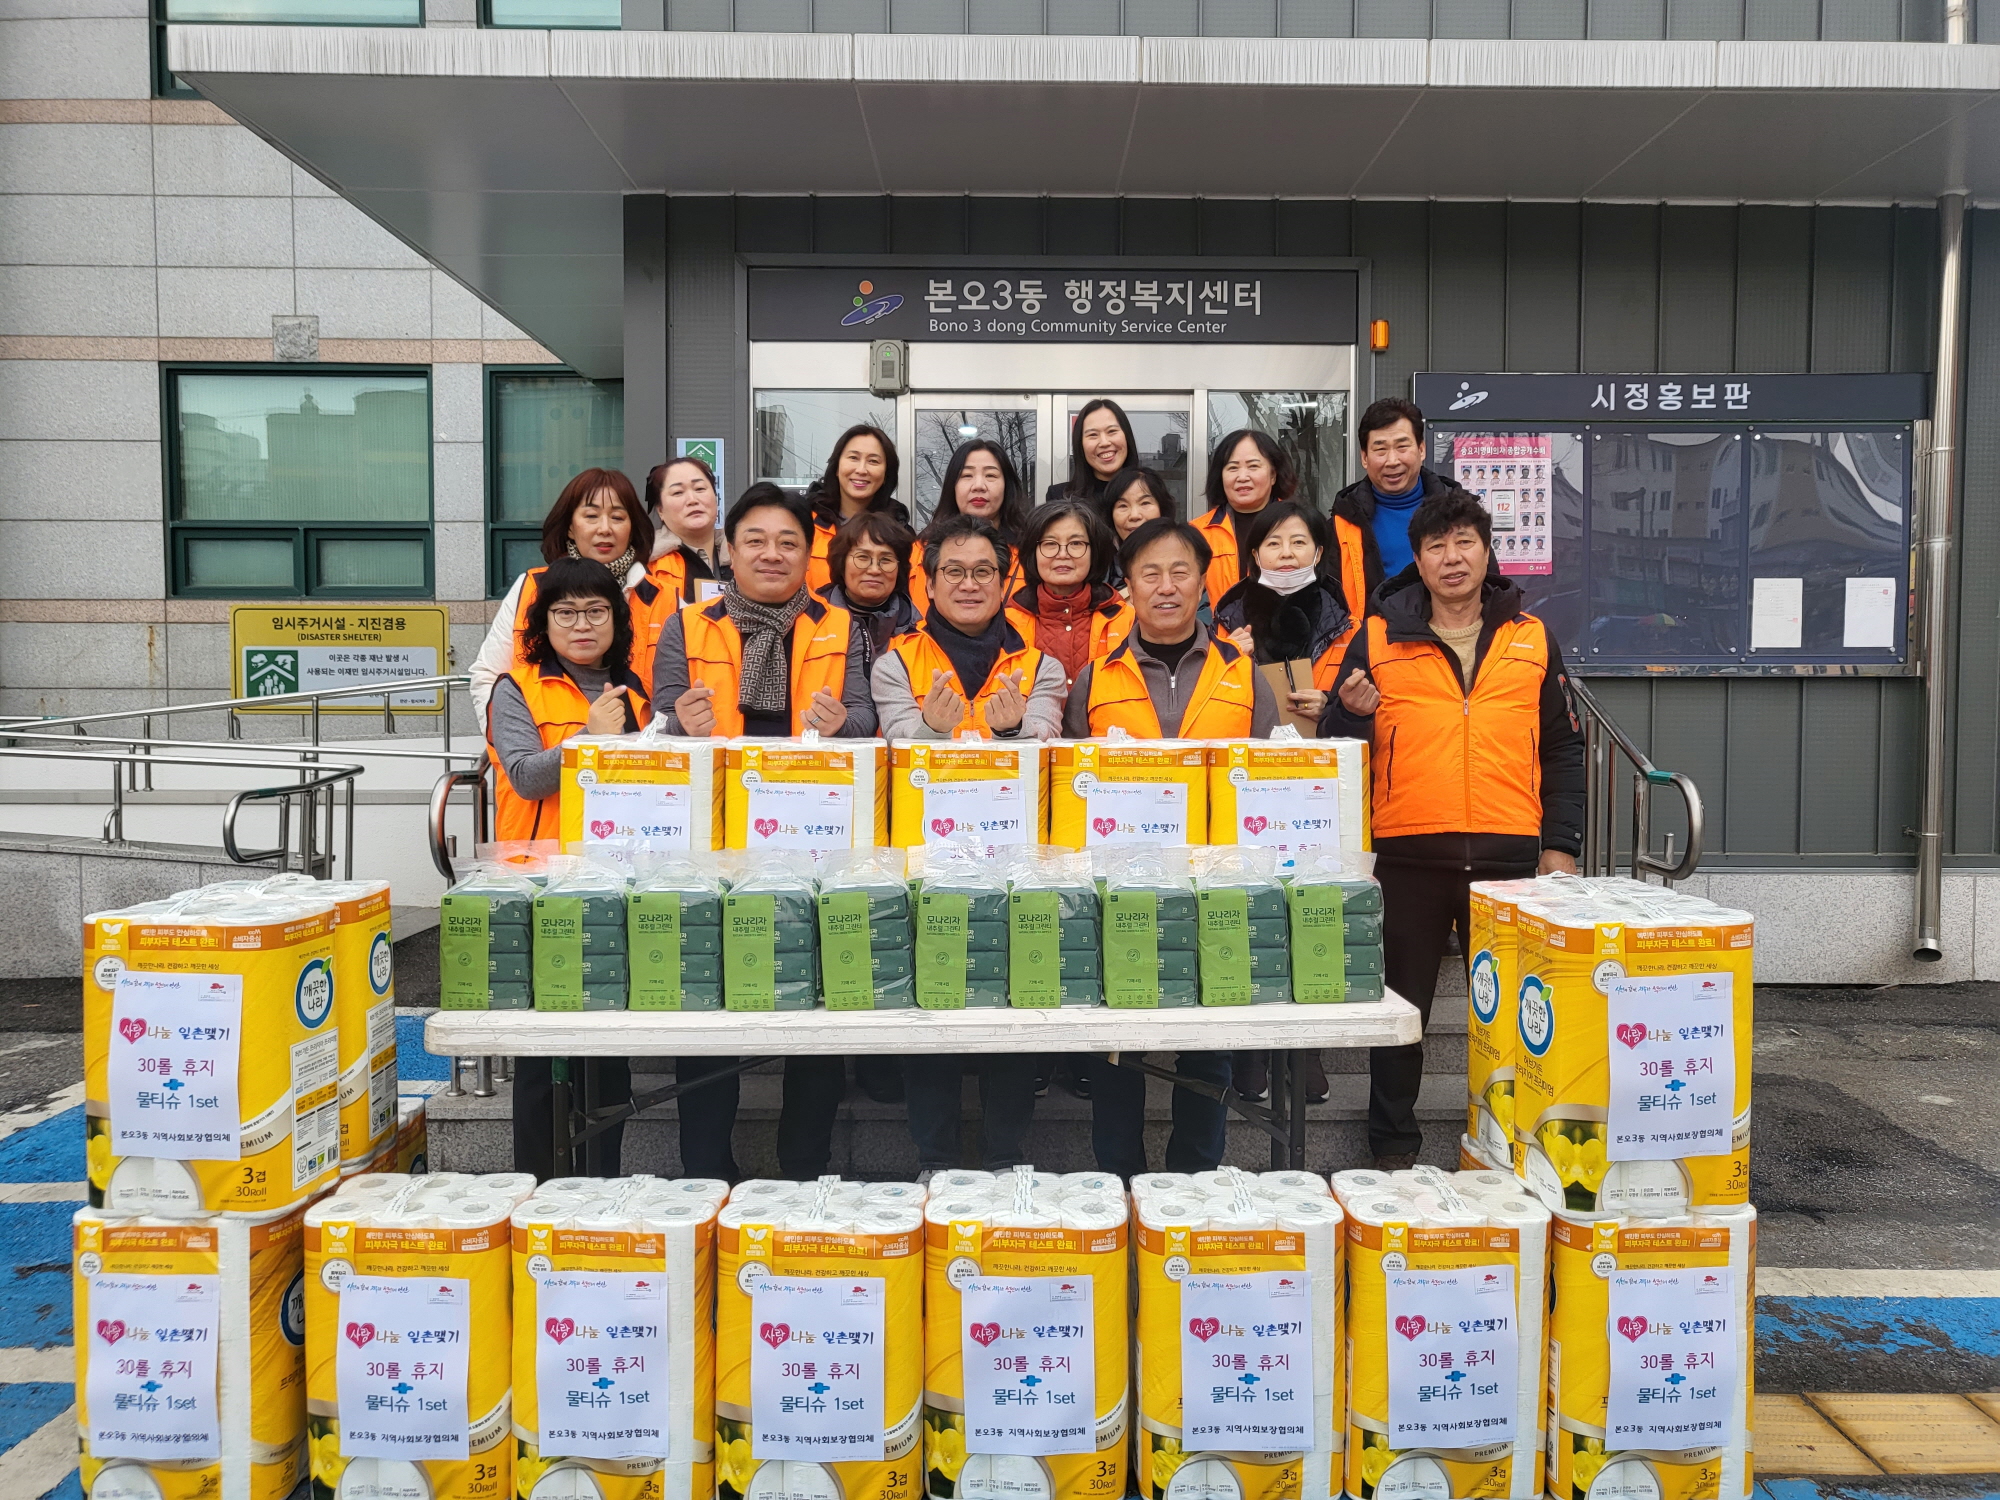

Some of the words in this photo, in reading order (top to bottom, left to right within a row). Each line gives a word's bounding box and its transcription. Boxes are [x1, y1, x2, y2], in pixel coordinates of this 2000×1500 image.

[924, 279, 1047, 314] 본오3동
[1064, 278, 1262, 316] 행정복지센터
[929, 319, 968, 334] Bono
[972, 320, 982, 334] 3
[986, 319, 1026, 336] dong
[1030, 319, 1116, 336] Community
[1121, 319, 1172, 334] Service
[1177, 319, 1227, 334] Center
[1591, 382, 1751, 411] 시정홍보판
[1497, 503, 1510, 511] 112
[272, 617, 346, 630] 임시주거시설
[358, 617, 406, 630] 지진겸용
[298, 633, 341, 642] (DISASTER
[343, 633, 382, 642] SHELTER)
[329, 654, 350, 662] 이곳은
[352, 654, 367, 663] 각종
[369, 654, 383, 663] 재난
[386, 654, 400, 663] 발생
[402, 654, 409, 662] 시
[307, 668, 335, 676] 사용되는
[338, 668, 359, 676] 이재민
[361, 668, 428, 676] 임시주거시설입니다.
[594, 824, 612, 835] 사랑
[616, 826, 635, 837] 나눔
[641, 826, 682, 836] 일촌맺기
[758, 823, 775, 833] 사랑
[779, 825, 799, 835] 나눔
[804, 825, 844, 835] 일촌맺기
[935, 822, 952, 834] 사랑
[956, 822, 975, 833] 나눔
[980, 819, 1018, 831] 일촌맺기
[1096, 821, 1113, 833] 사랑
[1117, 823, 1136, 833] 나눔
[1141, 823, 1178, 833] 일촌맺기
[1247, 819, 1264, 830] 사랑
[1269, 820, 1287, 831] 나눔
[1292, 819, 1331, 829] 일촌맺기
[638, 913, 672, 923] 모나리자
[827, 913, 861, 924] 모나리자
[927, 914, 960, 925] 모나리자
[1116, 912, 1149, 922] 모나리자
[1207, 911, 1240, 920] 모나리자
[1302, 907, 1335, 917] 모나리자
[449, 916, 482, 927] 모나리자
[541, 918, 575, 928] 모나리자
[733, 916, 767, 926] 모나리자
[139, 937, 169, 947] 피부자극
[172, 937, 197, 947] 테스트
[199, 937, 218, 947] 완료!
[1637, 939, 1669, 949] 피부자극
[1671, 939, 1695, 948] 테스트
[1698, 939, 1716, 948] 완료!
[304, 979, 327, 997] 깨끗한
[1477, 971, 1493, 992] 깨끗한
[308, 996, 323, 1011] 나라
[1478, 990, 1490, 1007] 나라
[1525, 998, 1546, 1023] 깨끗한
[122, 1022, 143, 1038] 사랑
[147, 1028, 173, 1040] 나눔
[179, 1027, 229, 1040] 일촌맺기
[1527, 1018, 1542, 1038] 나라
[1621, 1028, 1643, 1043] 사랑
[1649, 1029, 1672, 1042] 나눔
[1679, 1024, 1723, 1040] 일촌맺기
[138, 1058, 173, 1075] 30롤
[182, 1059, 214, 1077] 휴지
[1640, 1060, 1674, 1077] 30롤
[1684, 1057, 1712, 1076] 휴지
[136, 1092, 181, 1110] 물티슈
[189, 1095, 219, 1108] 1set
[1637, 1095, 1682, 1111] 물티슈
[1690, 1092, 1716, 1106] 1set
[121, 1131, 148, 1140] 본오3동
[153, 1132, 230, 1142] 지역사회보장협의체
[1617, 1134, 1645, 1143] 본오3동
[1651, 1129, 1723, 1142] 지역사회보장협의체
[550, 1324, 570, 1337] 사랑
[575, 1326, 600, 1338] 나눔
[606, 1326, 657, 1338] 일촌맺기
[975, 1329, 995, 1342] 사랑
[1002, 1327, 1026, 1339] 나눔
[1033, 1325, 1083, 1338] 일촌맺기
[1194, 1323, 1215, 1337] 사랑
[1221, 1325, 1246, 1337] 나눔
[1253, 1321, 1301, 1337] 일촌맺기
[1400, 1321, 1422, 1335] 사랑
[1427, 1322, 1452, 1335] 나눔
[1459, 1317, 1507, 1333] 일촌맺기
[1622, 1322, 1643, 1335] 사랑
[1649, 1323, 1673, 1335] 나눔
[1680, 1319, 1725, 1334] 일촌맺기
[101, 1327, 122, 1340] 사랑
[127, 1328, 150, 1341] 나눔
[156, 1328, 207, 1342] 일촌맺기
[350, 1329, 371, 1342] 사랑
[376, 1332, 401, 1343] 나눔
[408, 1330, 459, 1343] 일촌맺기
[765, 1330, 785, 1343] 사랑
[791, 1331, 816, 1344] 나눔
[823, 1331, 873, 1344] 일촌맺기
[567, 1358, 602, 1374] 30롤
[612, 1356, 644, 1374] 휴지
[994, 1356, 1029, 1372] 30롤
[1039, 1356, 1070, 1373] 휴지
[1212, 1354, 1248, 1370] 30롤
[1258, 1354, 1288, 1371] 휴지
[1420, 1352, 1454, 1369] 30롤
[1464, 1349, 1494, 1367] 휴지
[1641, 1354, 1674, 1370] 30롤
[1684, 1352, 1713, 1369] 휴지
[117, 1359, 151, 1378] 30롤
[159, 1360, 191, 1378] 휴지
[367, 1362, 401, 1379] 30롤
[411, 1362, 443, 1380] 휴지
[782, 1363, 818, 1379] 30롤
[828, 1363, 859, 1379] 휴지
[567, 1390, 611, 1408] 물티슈
[620, 1391, 649, 1404] 1set
[993, 1388, 1038, 1405] 물티슈
[1046, 1390, 1075, 1404] 1set
[1211, 1386, 1257, 1403] 물티슈
[1265, 1388, 1294, 1401] 1set
[1417, 1385, 1463, 1402] 물티슈
[1470, 1382, 1498, 1395] 1set
[1637, 1387, 1681, 1403] 물티슈
[1690, 1387, 1716, 1399] 1set
[113, 1394, 159, 1410] 물티슈
[166, 1395, 197, 1410] 1set
[366, 1395, 410, 1412] 물티슈
[418, 1398, 447, 1411] 1set
[780, 1396, 826, 1413] 물티슈
[835, 1397, 864, 1410] 1set
[975, 1428, 1003, 1437] 본오3동
[1009, 1427, 1085, 1438] 지역사회보장협의체
[1192, 1426, 1220, 1434] 본오3동
[1226, 1425, 1303, 1434] 지역사회보장협의체
[1398, 1423, 1427, 1432] 본오3동
[1433, 1418, 1507, 1432] 지역사회보장협의체
[1615, 1425, 1643, 1433] 본오3동
[1649, 1421, 1721, 1434] 지역사회보장협의체
[350, 1431, 377, 1441] 본오3동
[382, 1434, 459, 1443] 지역사회보장협의체
[549, 1430, 577, 1438] 본오3동
[582, 1429, 659, 1440] 지역사회보장협의체
[762, 1434, 790, 1443] 본오3동
[796, 1435, 874, 1445] 지역사회보장협의체
[475, 1463, 497, 1481] 3겹
